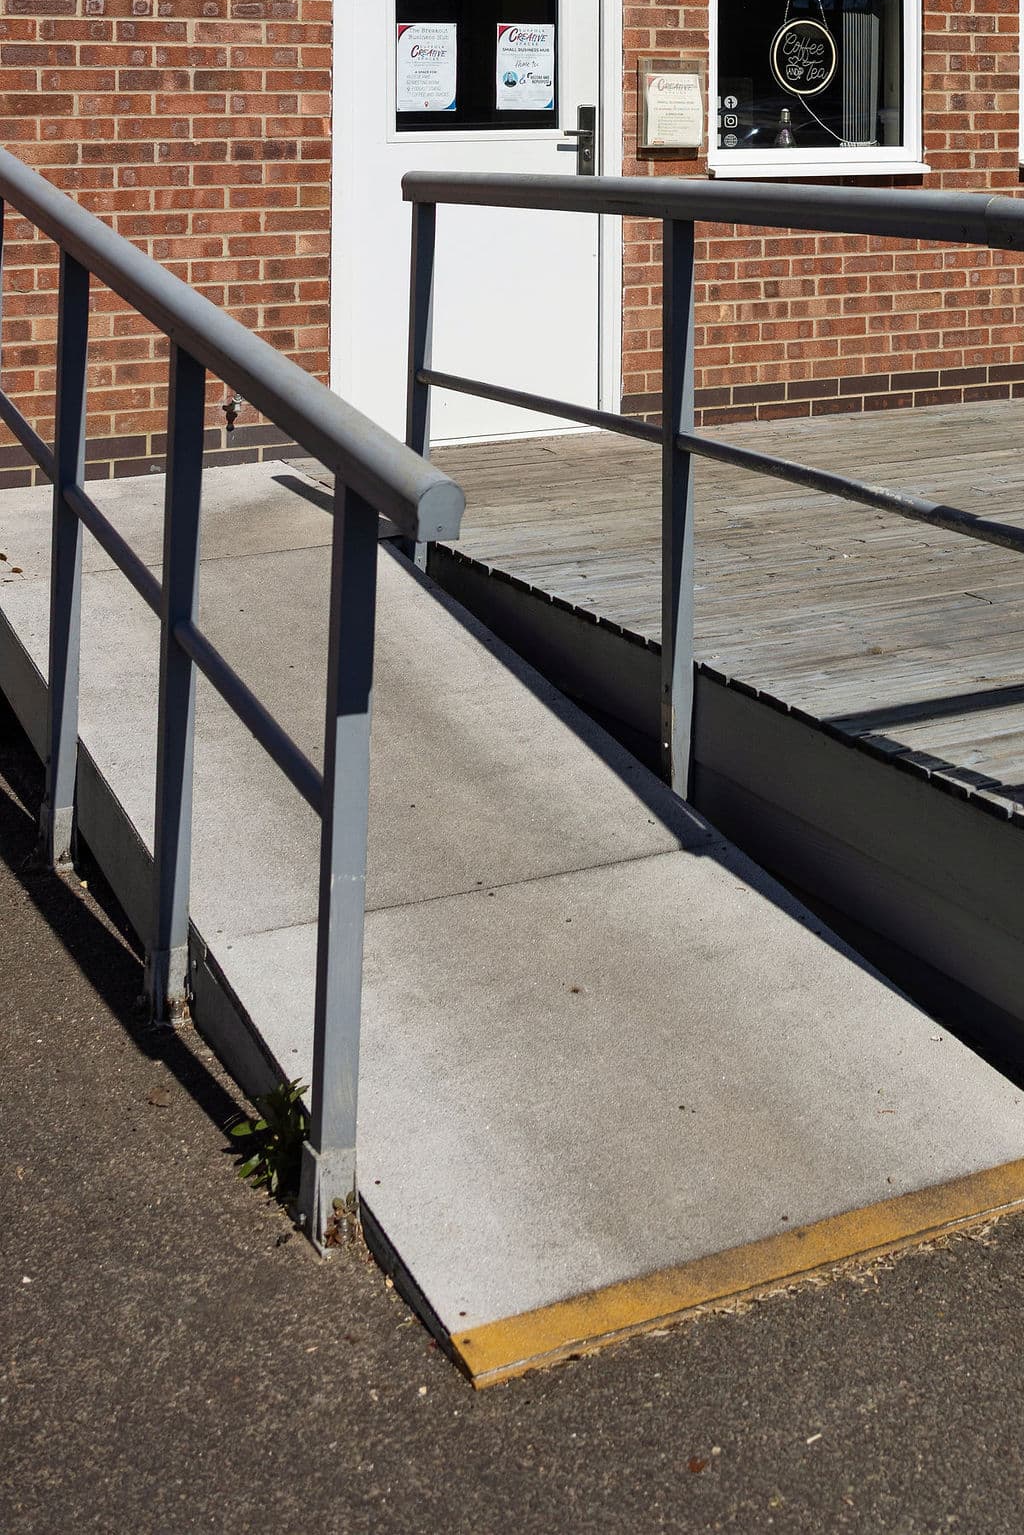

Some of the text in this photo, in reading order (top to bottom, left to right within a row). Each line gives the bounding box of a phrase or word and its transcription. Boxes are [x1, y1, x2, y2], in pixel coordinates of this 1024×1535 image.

[508, 27, 548, 43] CREATIVE
[783, 33, 825, 63] Coffee
[805, 61, 829, 81] Tea
